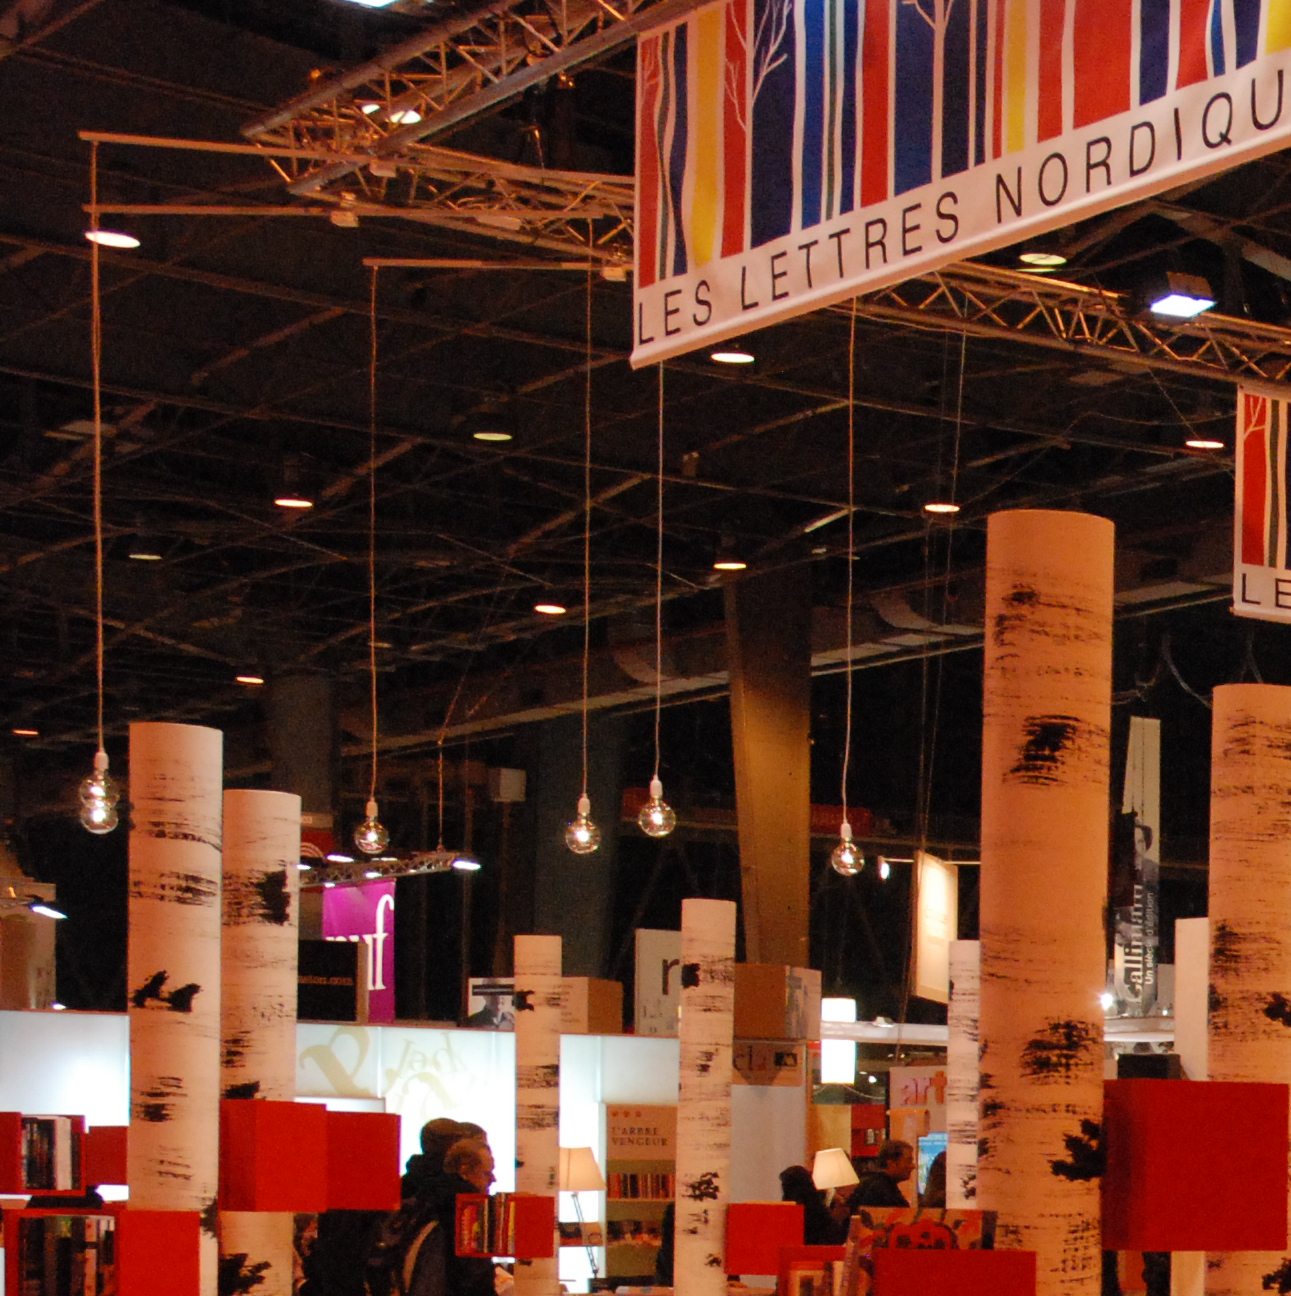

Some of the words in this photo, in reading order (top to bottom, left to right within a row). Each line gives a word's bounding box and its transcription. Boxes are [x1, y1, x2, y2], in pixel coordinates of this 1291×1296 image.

[637, 283, 713, 345] LES
[741, 191, 960, 310] LETTRES
[611, 1137, 668, 1146] VENGEUR
